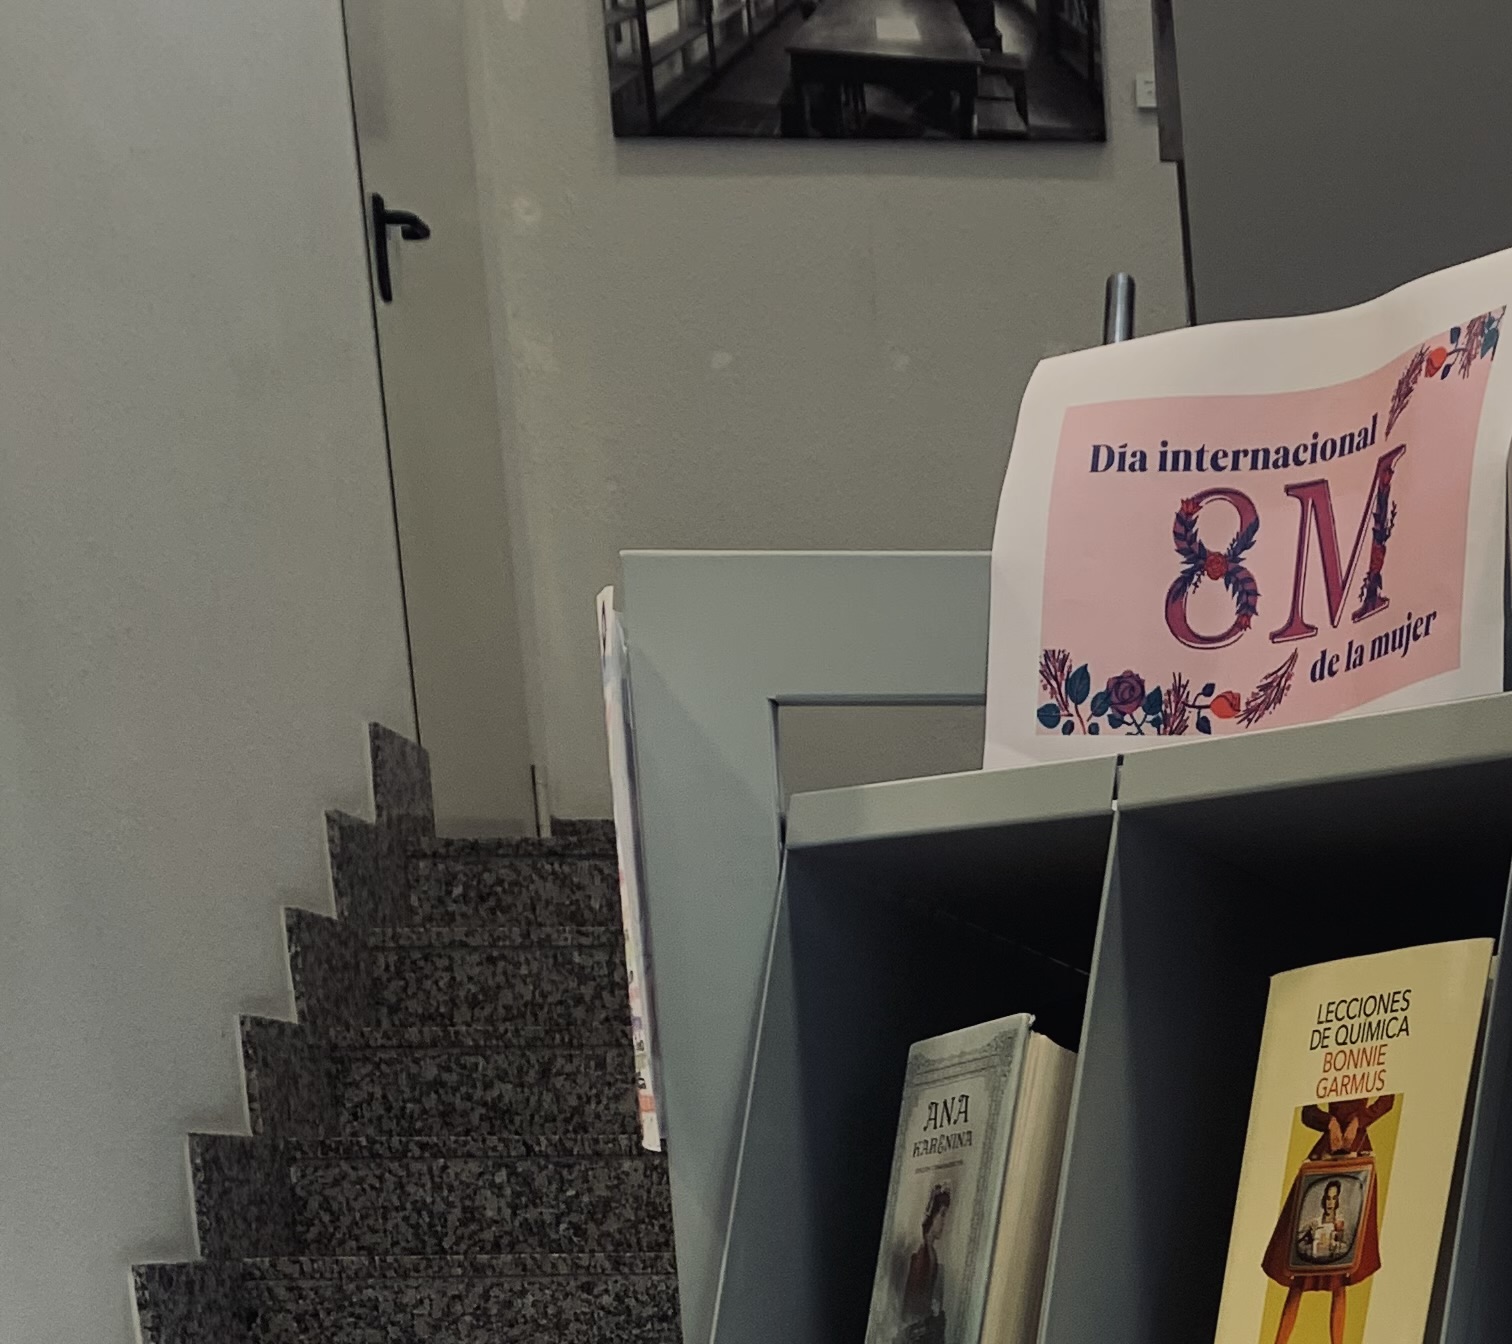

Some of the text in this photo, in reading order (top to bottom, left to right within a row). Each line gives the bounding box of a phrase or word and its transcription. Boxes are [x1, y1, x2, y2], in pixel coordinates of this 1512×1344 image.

[1090, 412, 1378, 473] Día internacional
[1164, 443, 1407, 650] 8M
[1309, 611, 1438, 683] de la mujer
[1317, 989, 1412, 1025] LECCIONES
[1309, 1015, 1409, 1050] DE QUÍMICA
[1323, 1044, 1388, 1073] BONNIE
[1316, 1069, 1387, 1099] GARMUS
[923, 1094, 969, 1132] ANA
[912, 1130, 972, 1158] KARENINA
